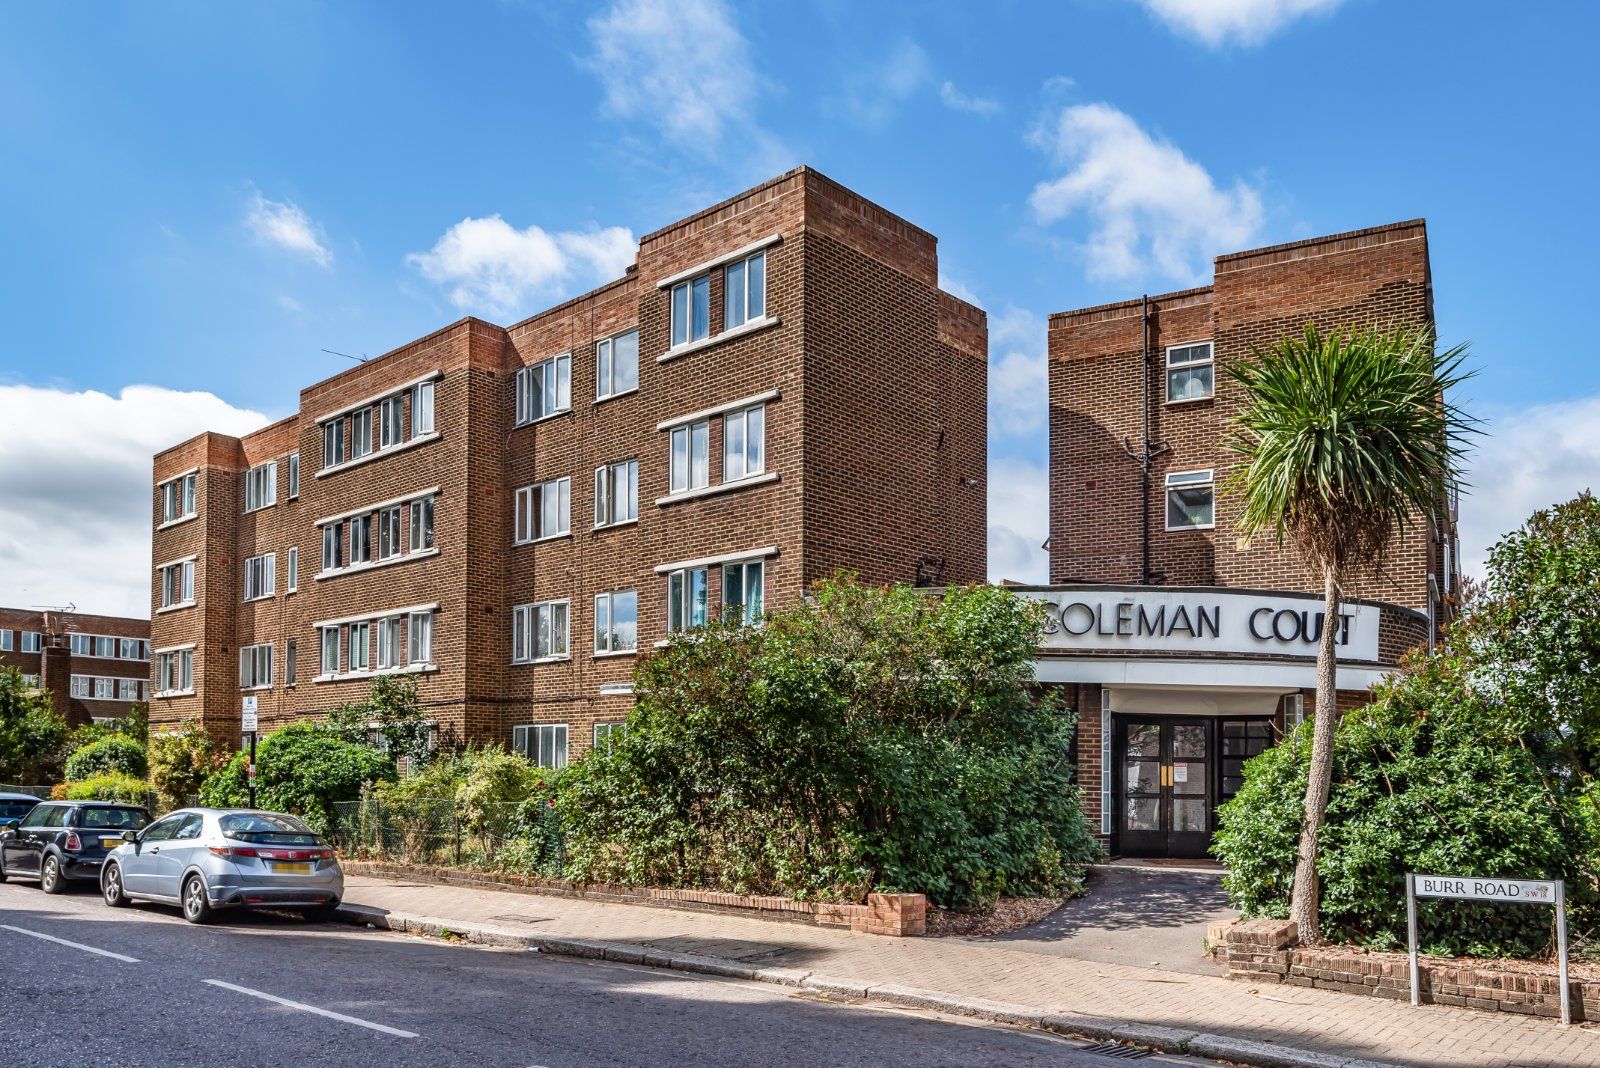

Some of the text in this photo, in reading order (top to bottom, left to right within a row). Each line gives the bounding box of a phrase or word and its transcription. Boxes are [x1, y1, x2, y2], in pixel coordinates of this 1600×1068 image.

[1249, 607, 1355, 646] COUT
[1424, 880, 1466, 894] BURR
[1474, 882, 1520, 897] ROAD
